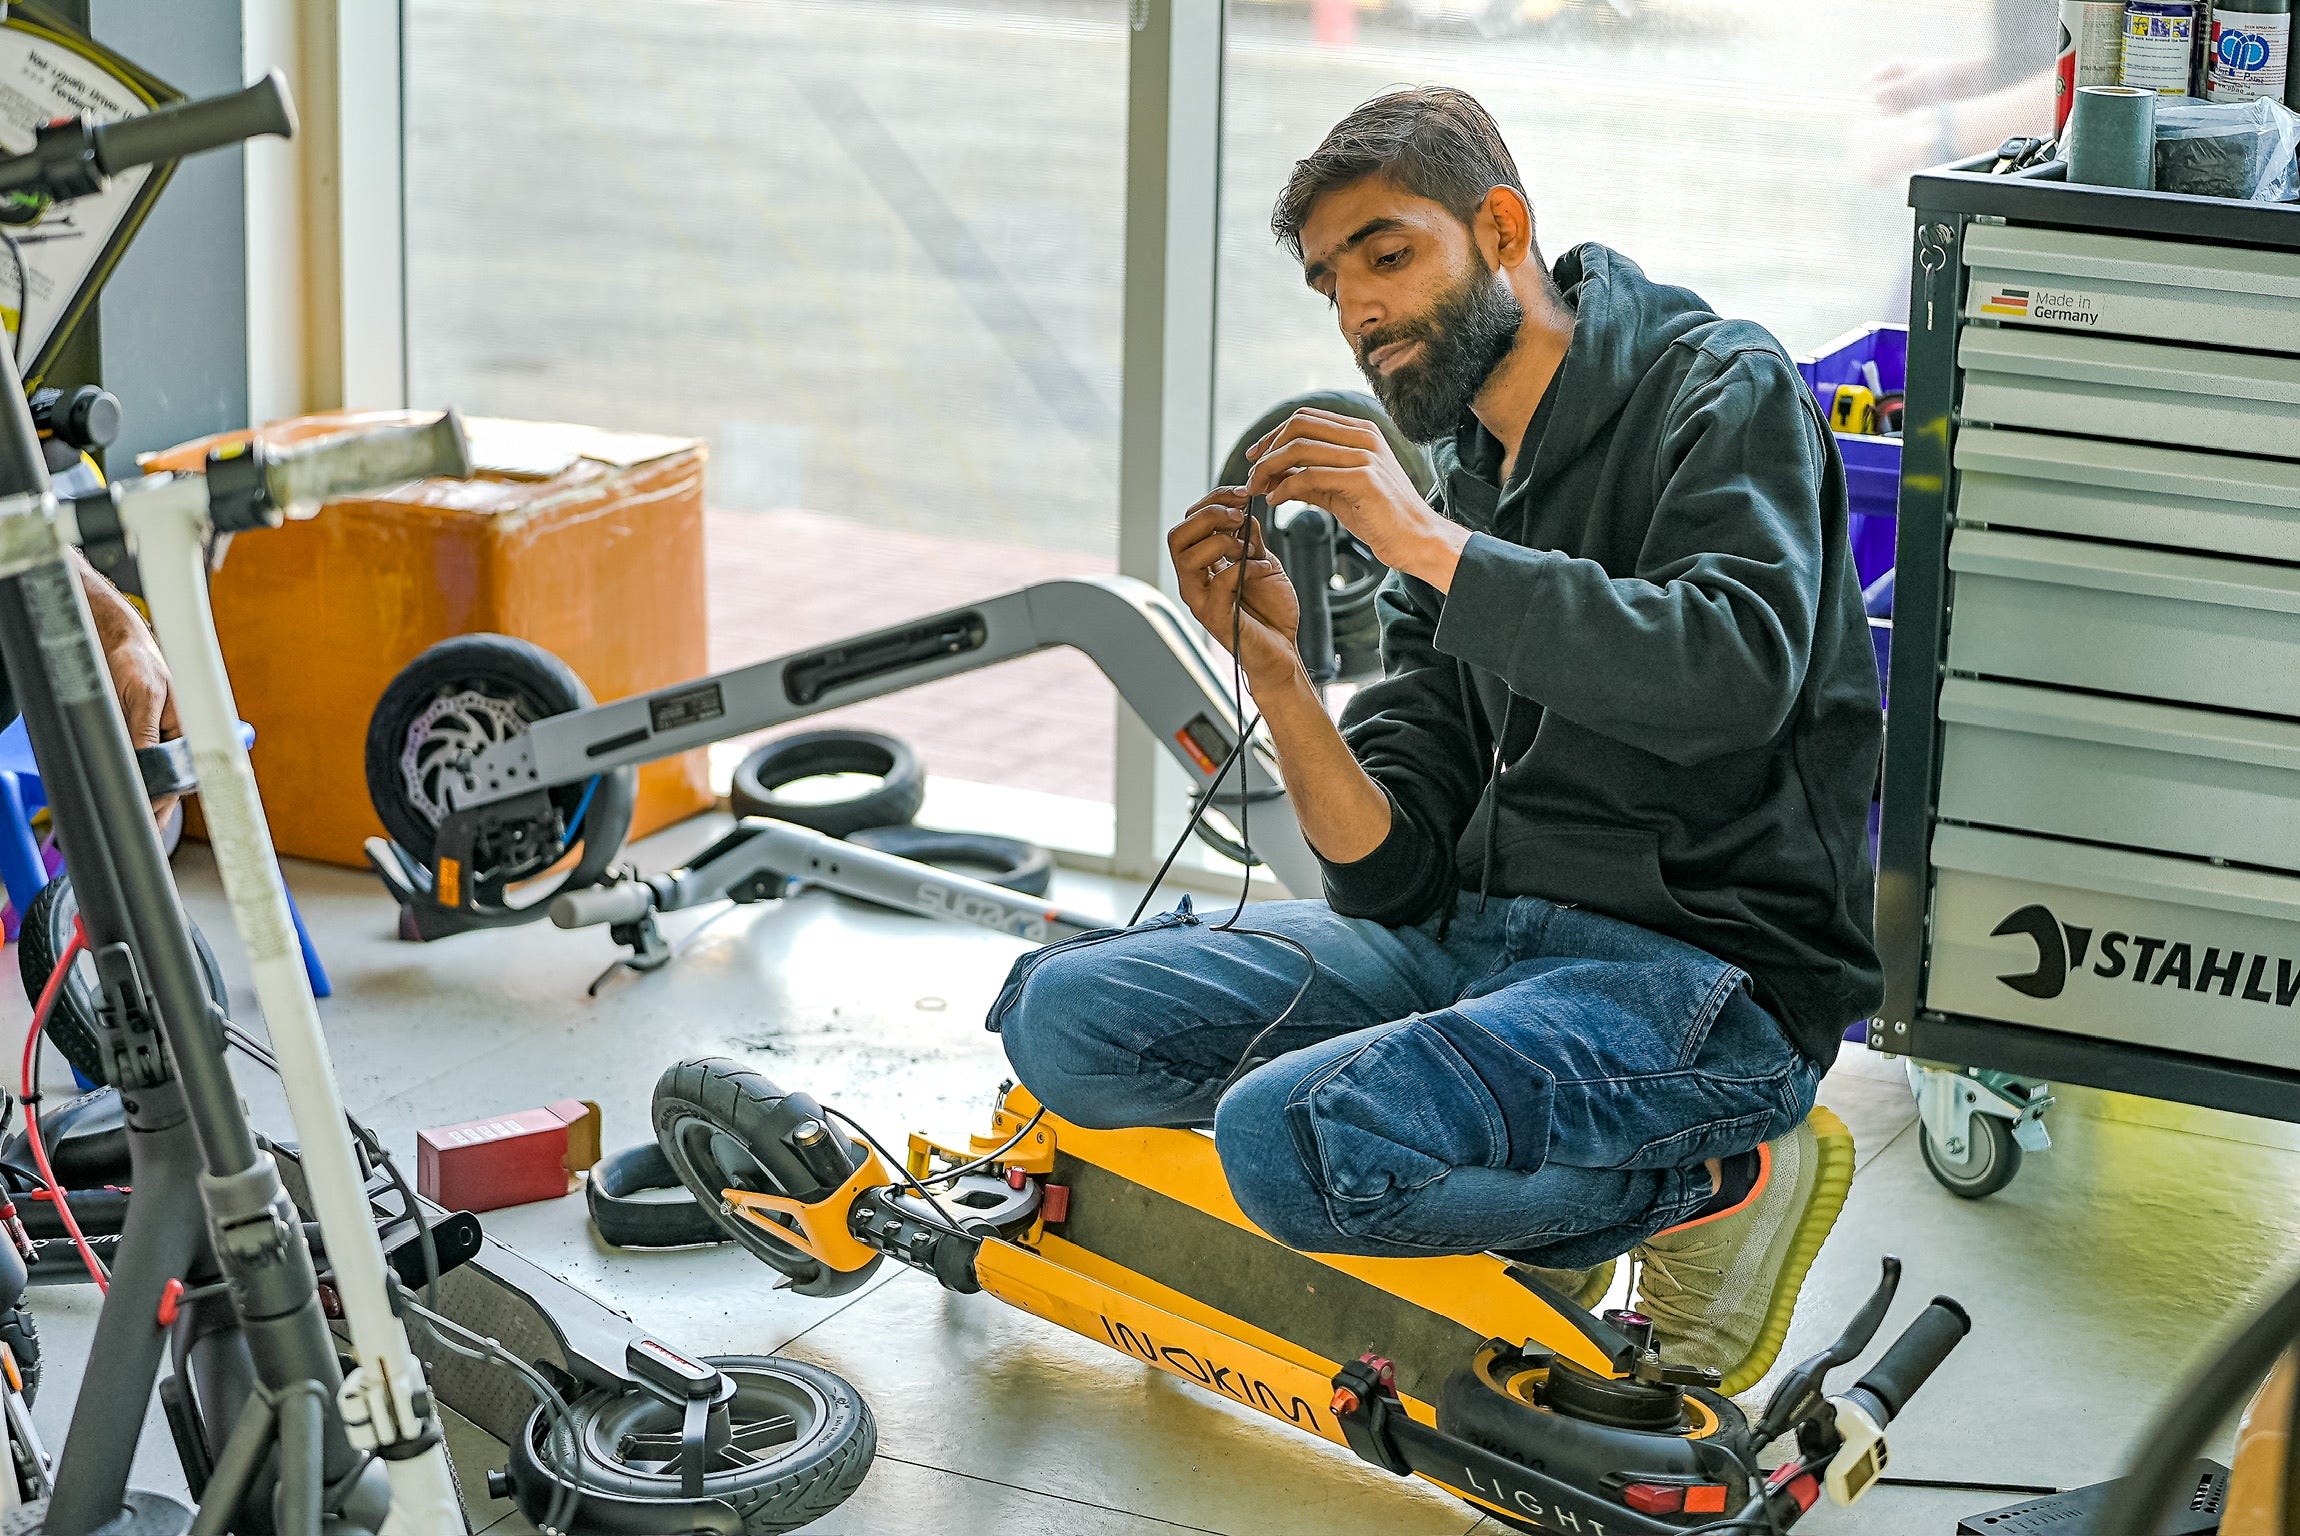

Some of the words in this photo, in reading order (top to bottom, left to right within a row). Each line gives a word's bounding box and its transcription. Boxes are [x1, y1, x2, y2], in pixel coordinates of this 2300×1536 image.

[2034, 306, 2098, 325] Germany
[2036, 292, 2073, 307] Made
[2079, 295, 2091, 309] in
[1100, 1315, 1321, 1432] INOKIM
[1465, 1467, 1608, 1536] LIGHT
